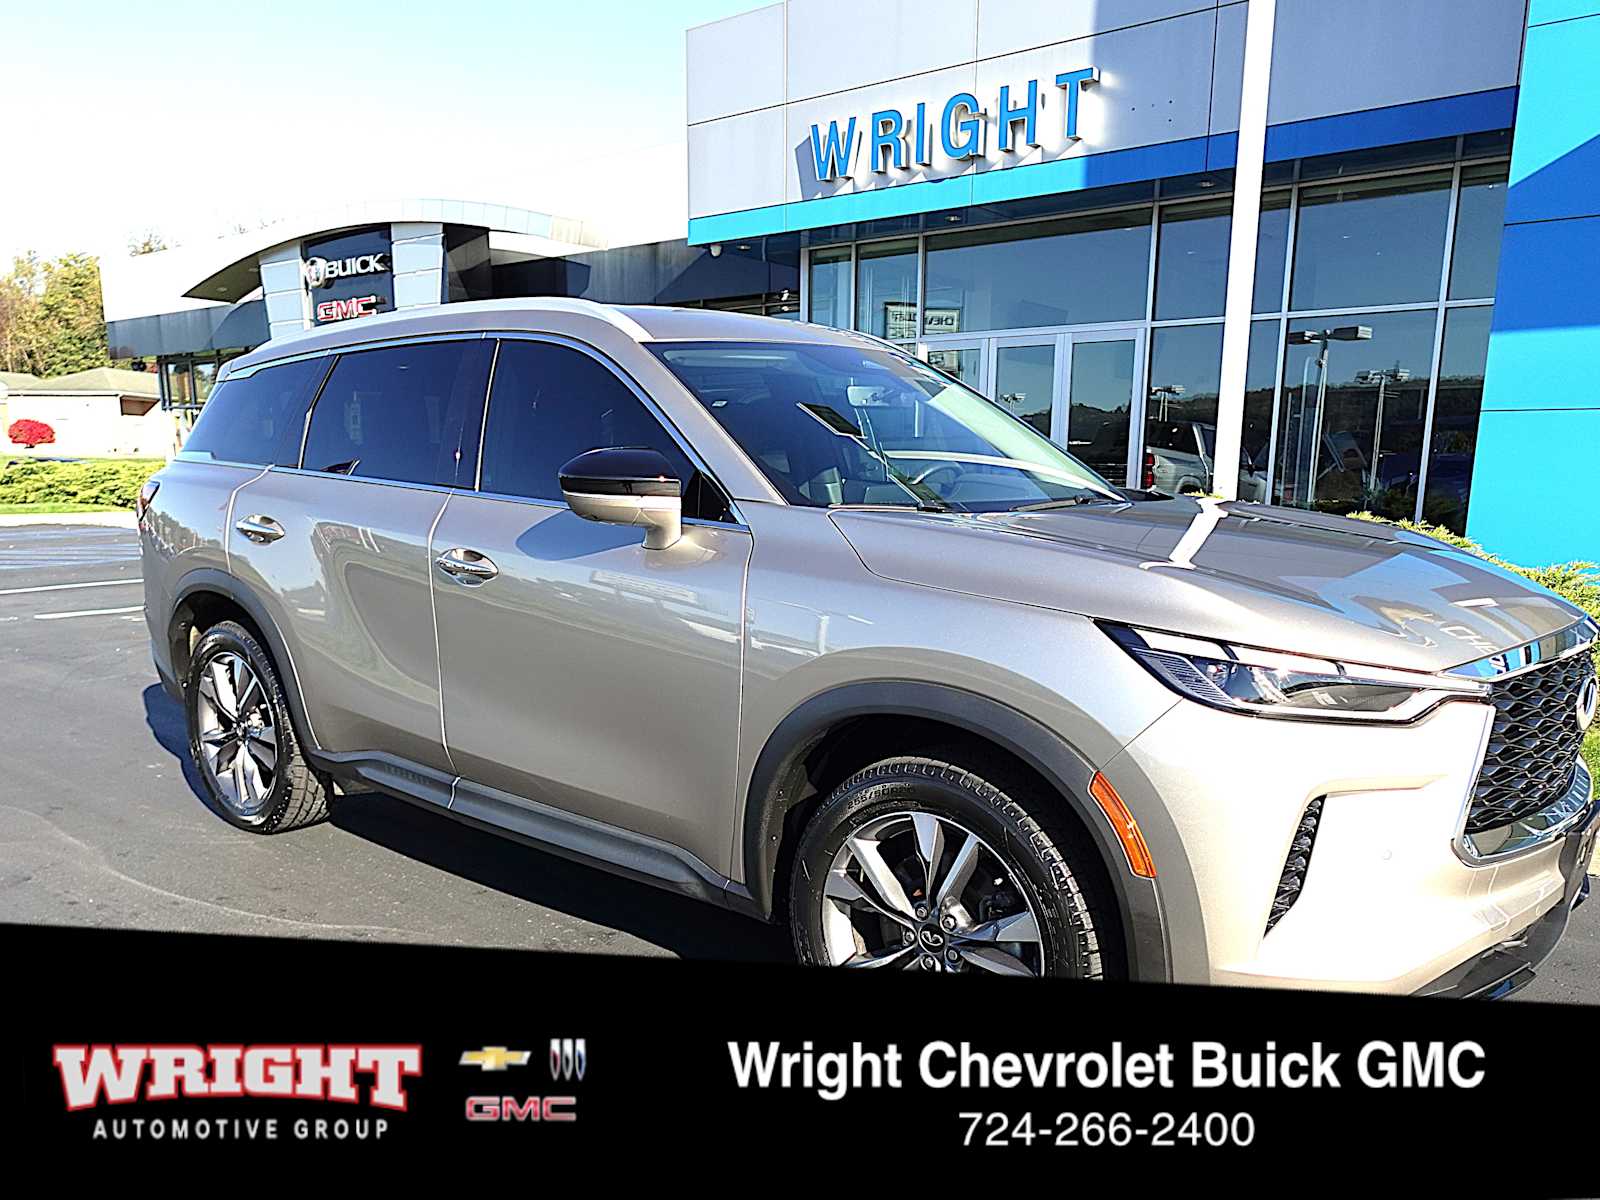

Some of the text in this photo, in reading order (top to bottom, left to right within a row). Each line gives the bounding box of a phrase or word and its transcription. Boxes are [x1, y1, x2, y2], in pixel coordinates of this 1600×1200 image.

[809, 66, 1100, 182] WRIGHT
[325, 253, 385, 278] BUICK
[317, 295, 377, 321] GMC
